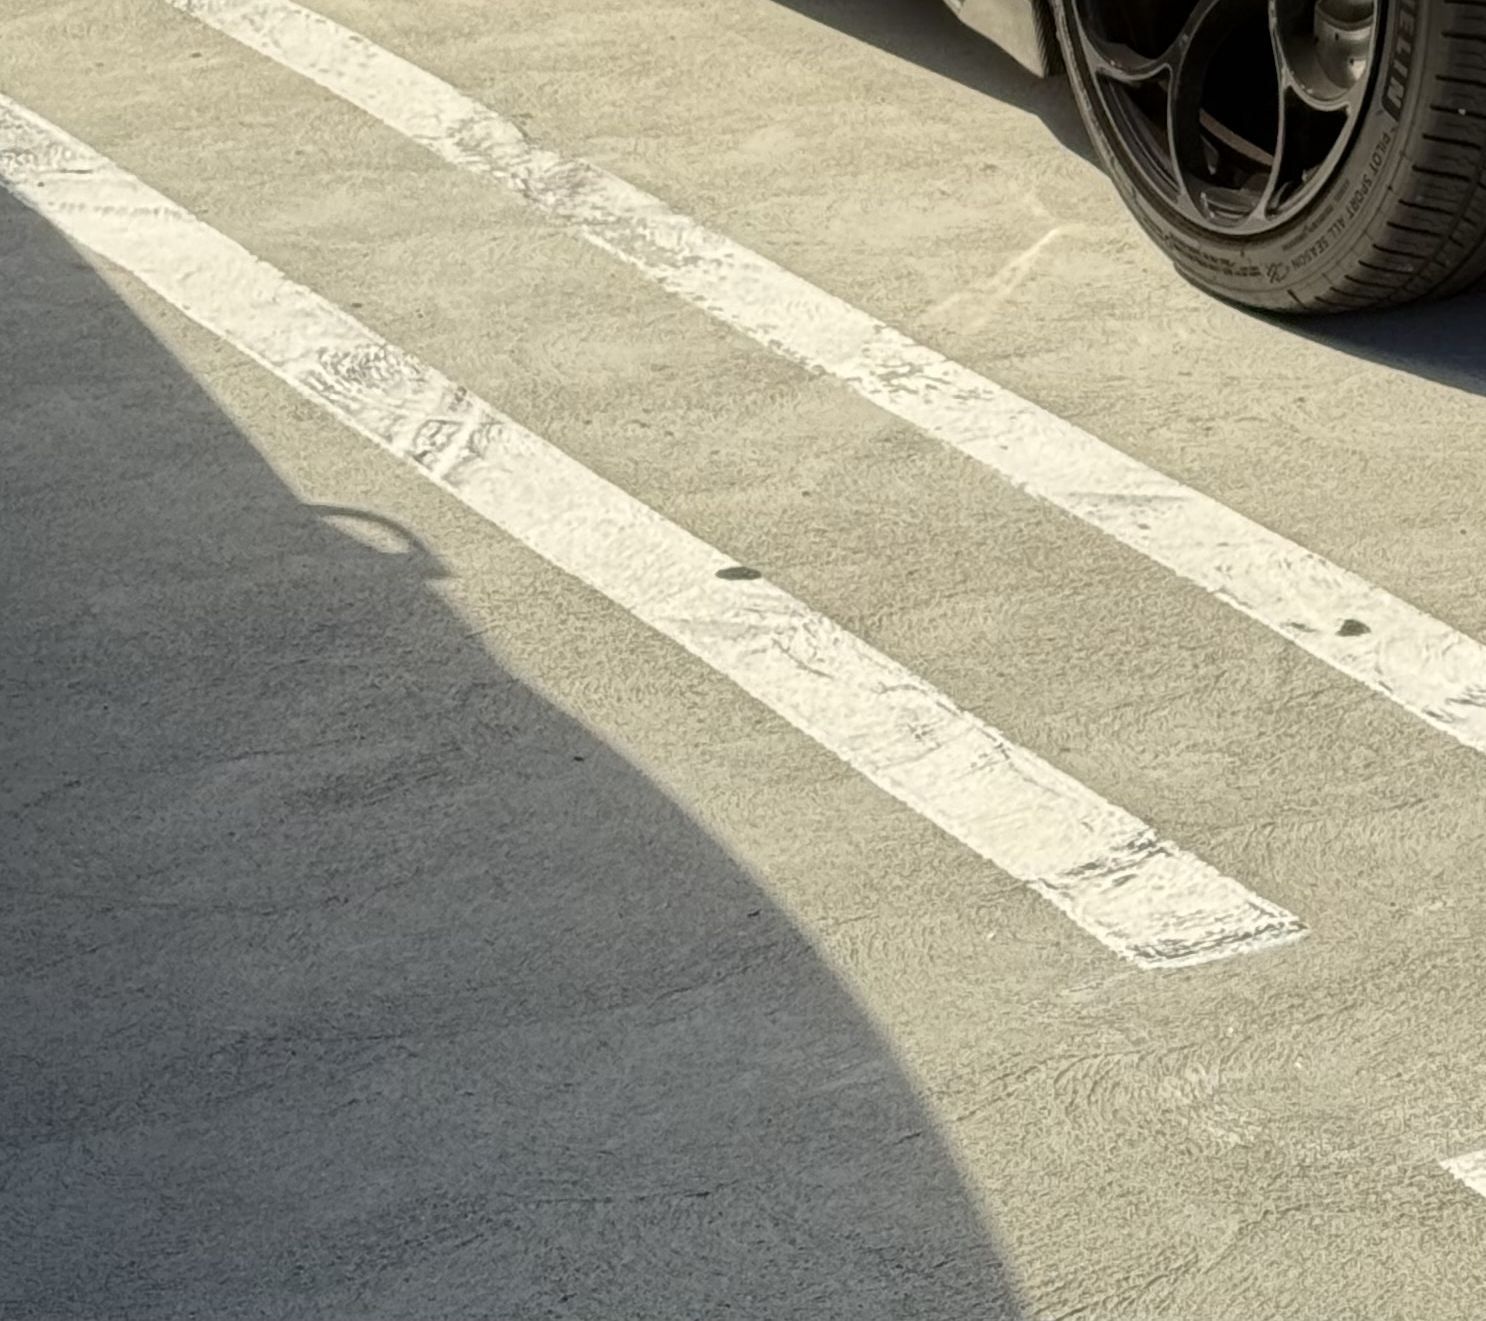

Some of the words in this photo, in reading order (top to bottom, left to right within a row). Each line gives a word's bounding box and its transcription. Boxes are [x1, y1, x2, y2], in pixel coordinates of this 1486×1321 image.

[1369, 131, 1391, 177] PILOT
[1346, 174, 1373, 219] SPORT
[1327, 217, 1346, 237] ALL
[1291, 238, 1330, 271] SEASON
